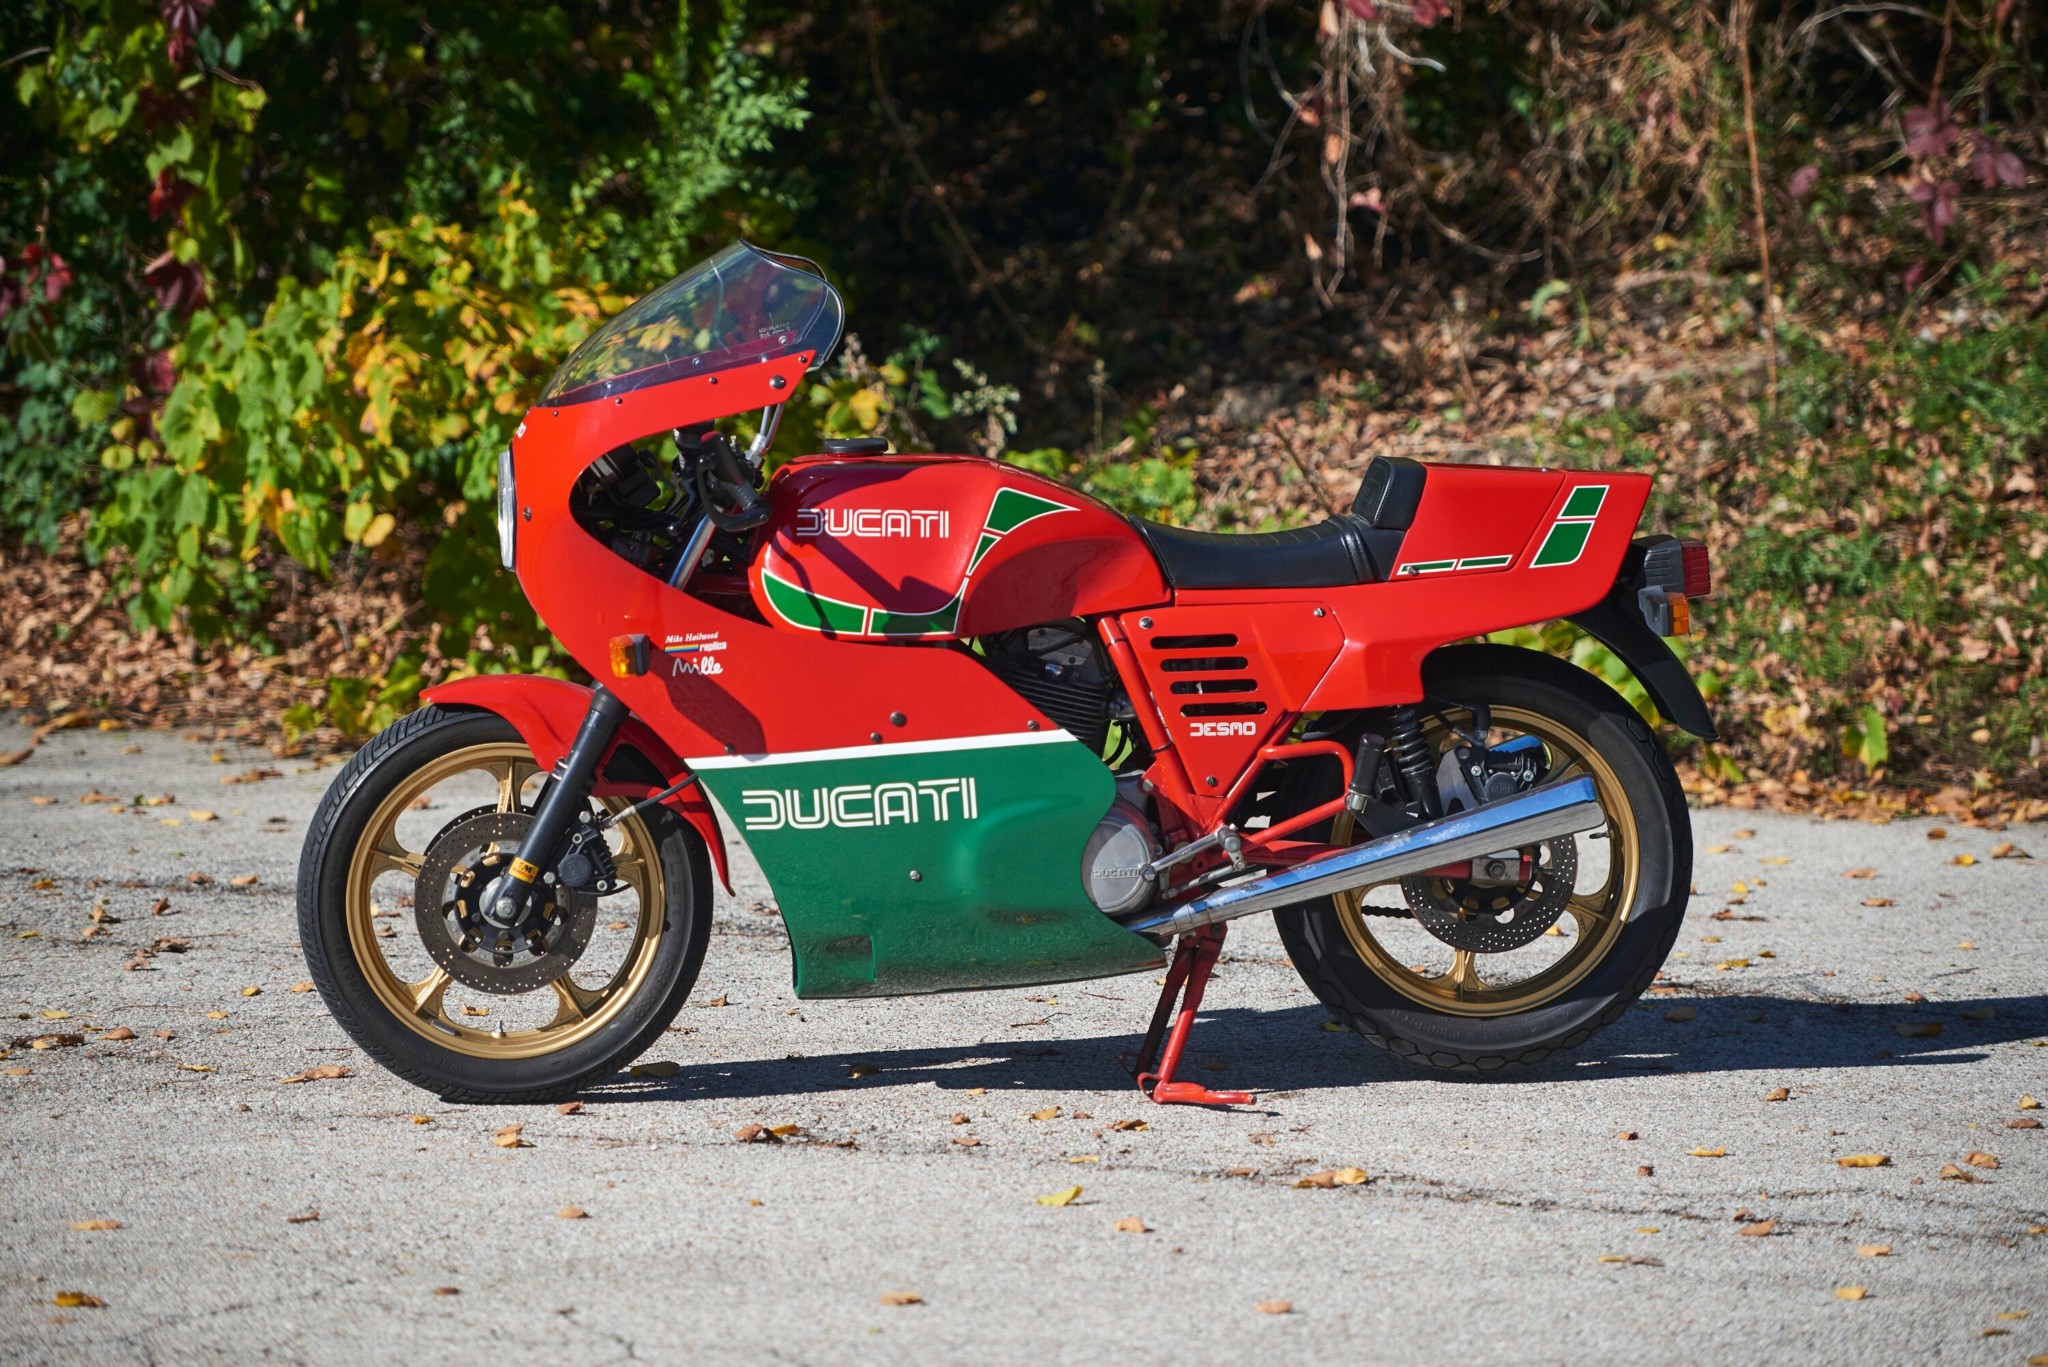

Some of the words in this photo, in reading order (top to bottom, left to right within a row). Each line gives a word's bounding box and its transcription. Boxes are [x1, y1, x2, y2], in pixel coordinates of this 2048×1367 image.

[797, 509, 949, 538] DUCATI
[665, 635, 683, 644] Mike
[685, 631, 718, 642] Hailwood
[699, 641, 727, 652] replica
[672, 656, 723, 676] Mille
[1189, 721, 1257, 737] DESMO
[742, 778, 977, 830] DUCATI
[1093, 868, 1139, 879] DUCATI
